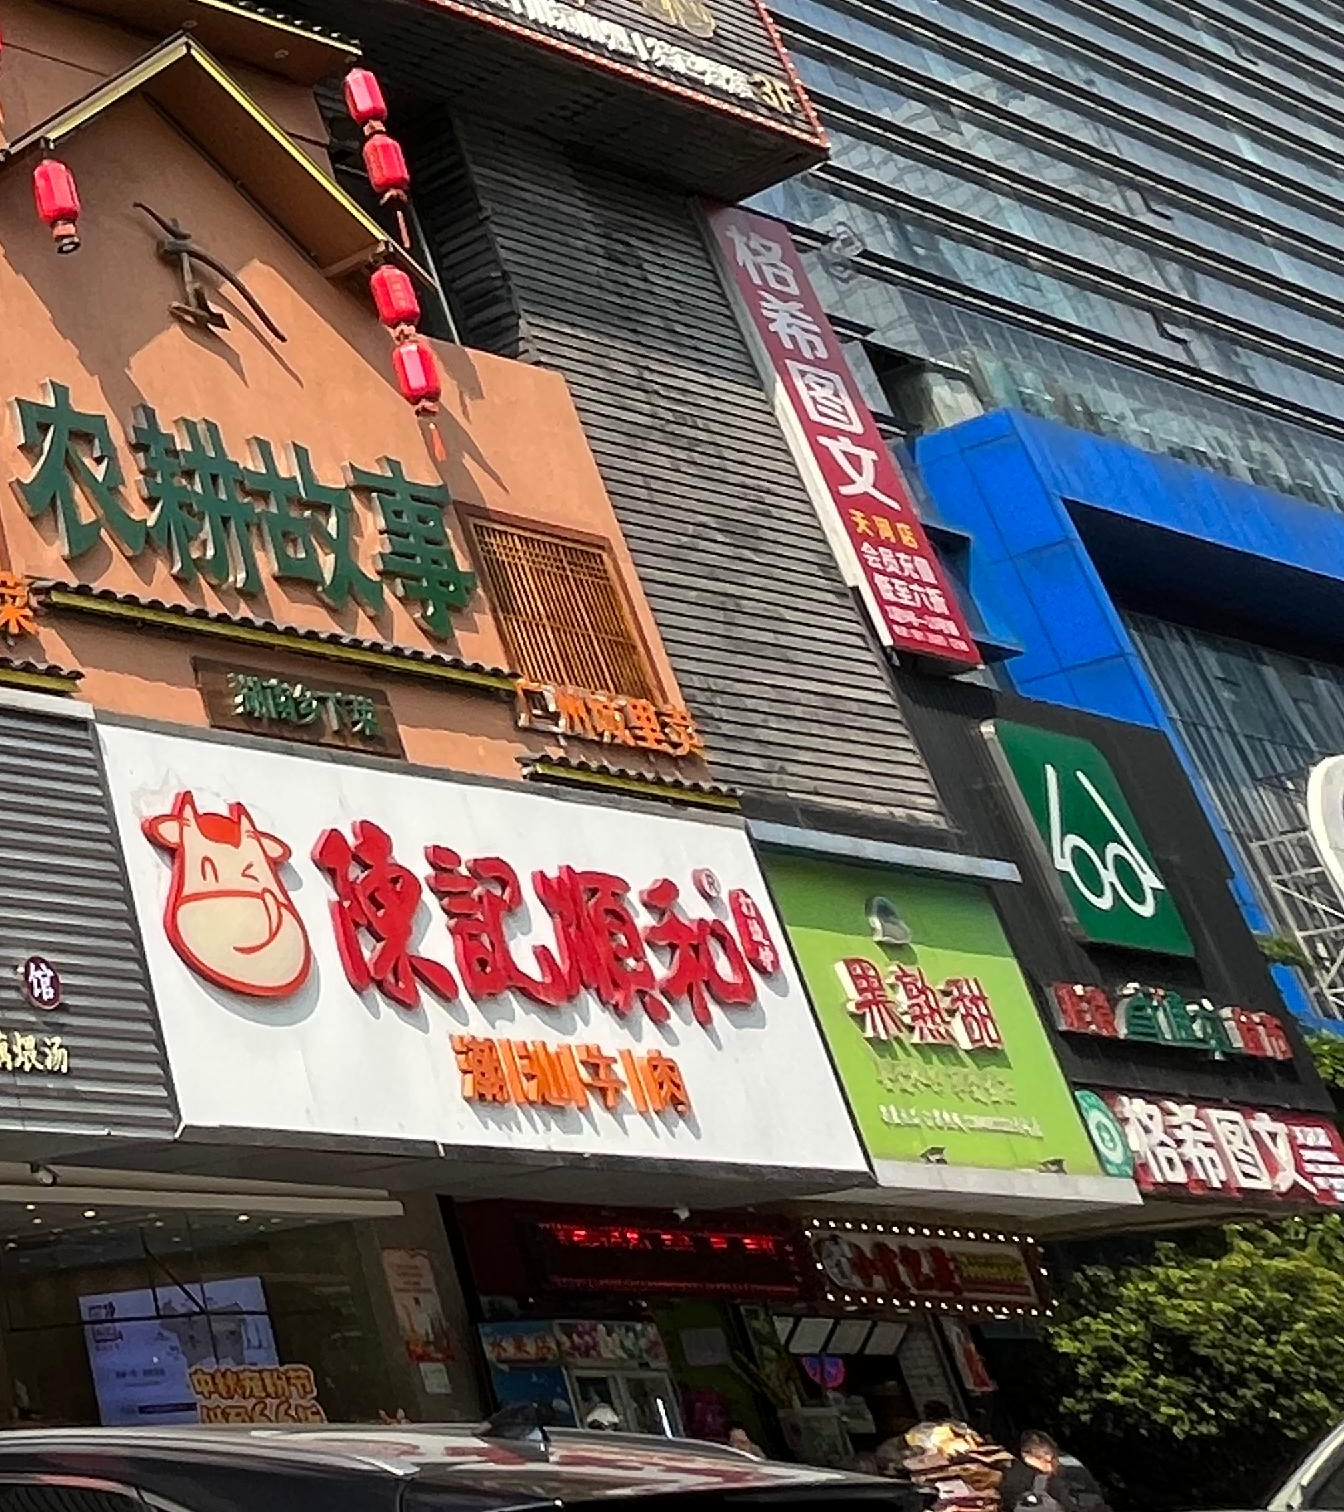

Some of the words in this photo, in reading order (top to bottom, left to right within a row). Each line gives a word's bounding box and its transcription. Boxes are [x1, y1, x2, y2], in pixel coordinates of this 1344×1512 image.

[725, 224, 902, 513] 格希图文
[9, 377, 478, 641] 农耕故事
[848, 507, 920, 550] 天河店
[310, 818, 760, 1030] 陳記順和
[448, 1031, 693, 1115] 潮汕牛肉
[1116, 1094, 1318, 1195] 格希图文
